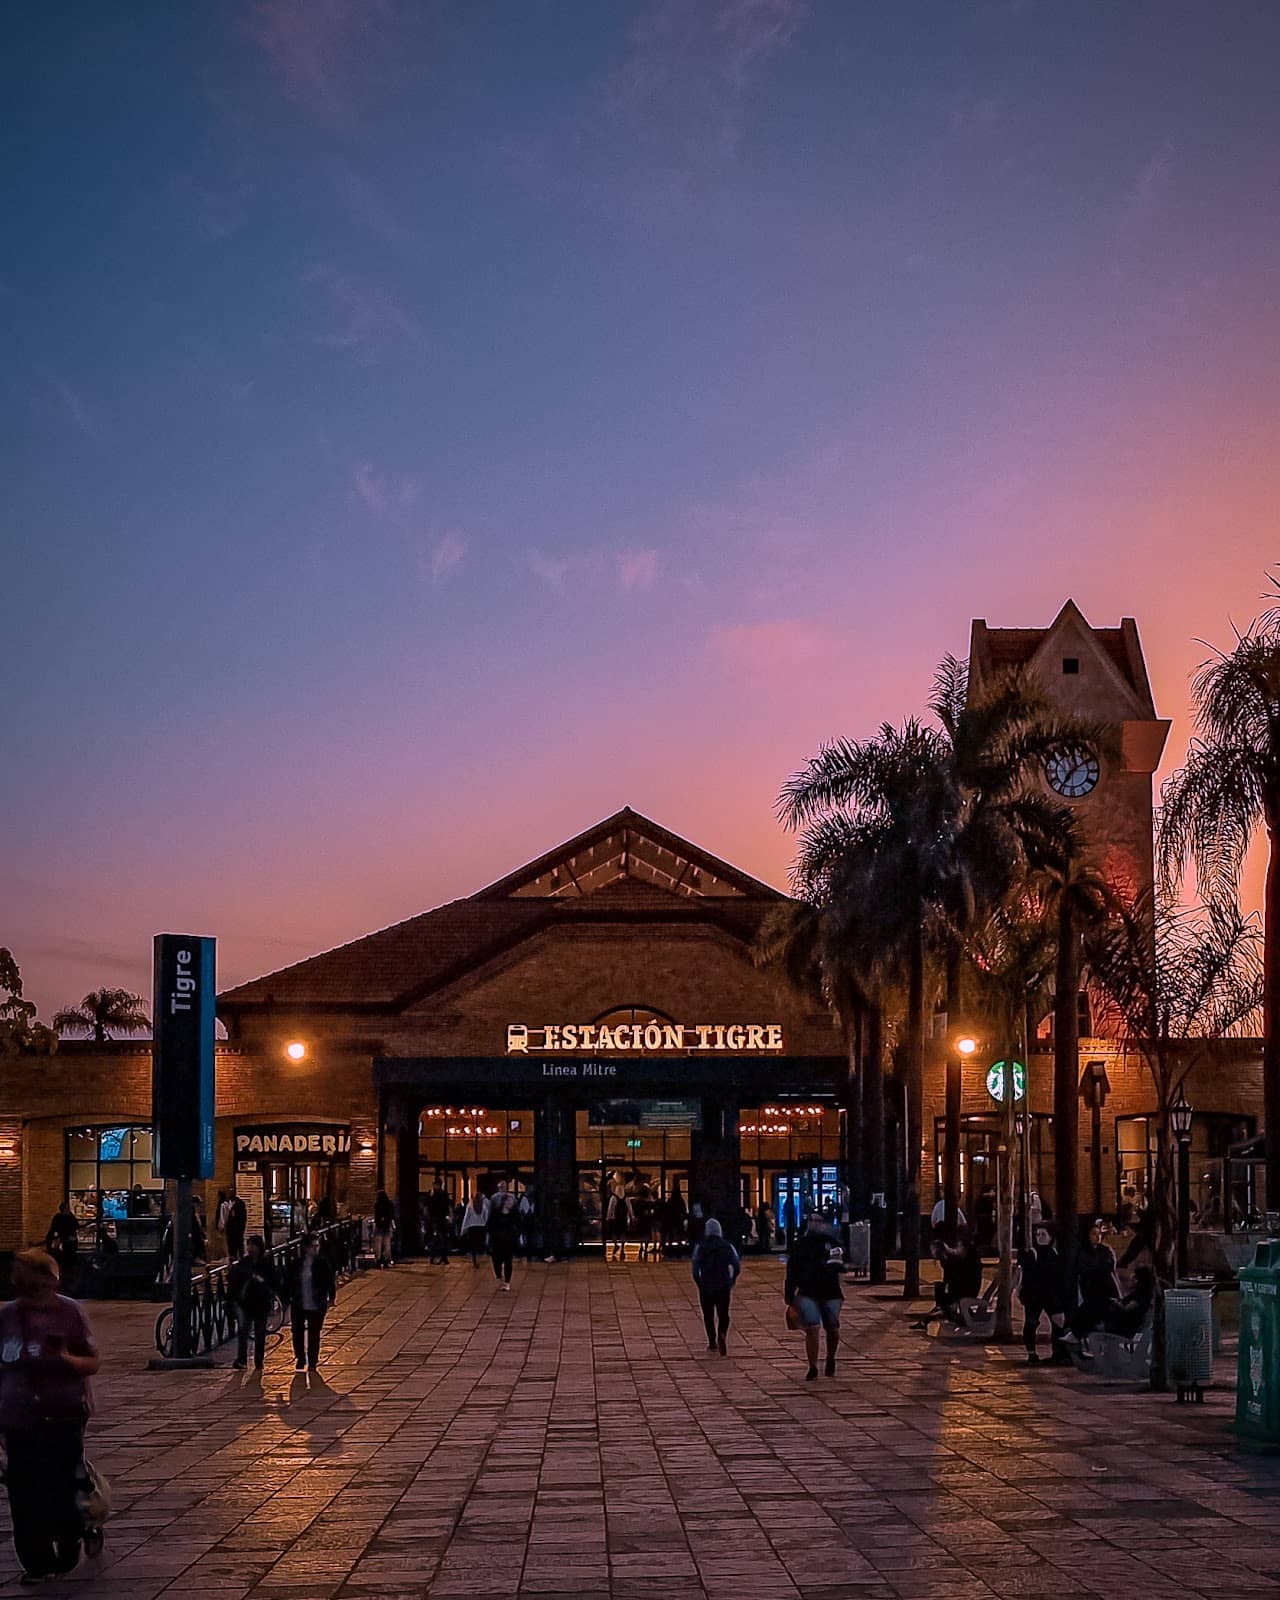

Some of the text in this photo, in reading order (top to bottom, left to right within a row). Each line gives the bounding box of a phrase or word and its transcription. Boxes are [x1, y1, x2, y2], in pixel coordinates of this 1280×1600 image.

[171, 950, 196, 1015] Tigre
[543, 1018, 783, 1050] ESTACIÓN TIGRE
[582, 1063, 617, 1076] Mitre
